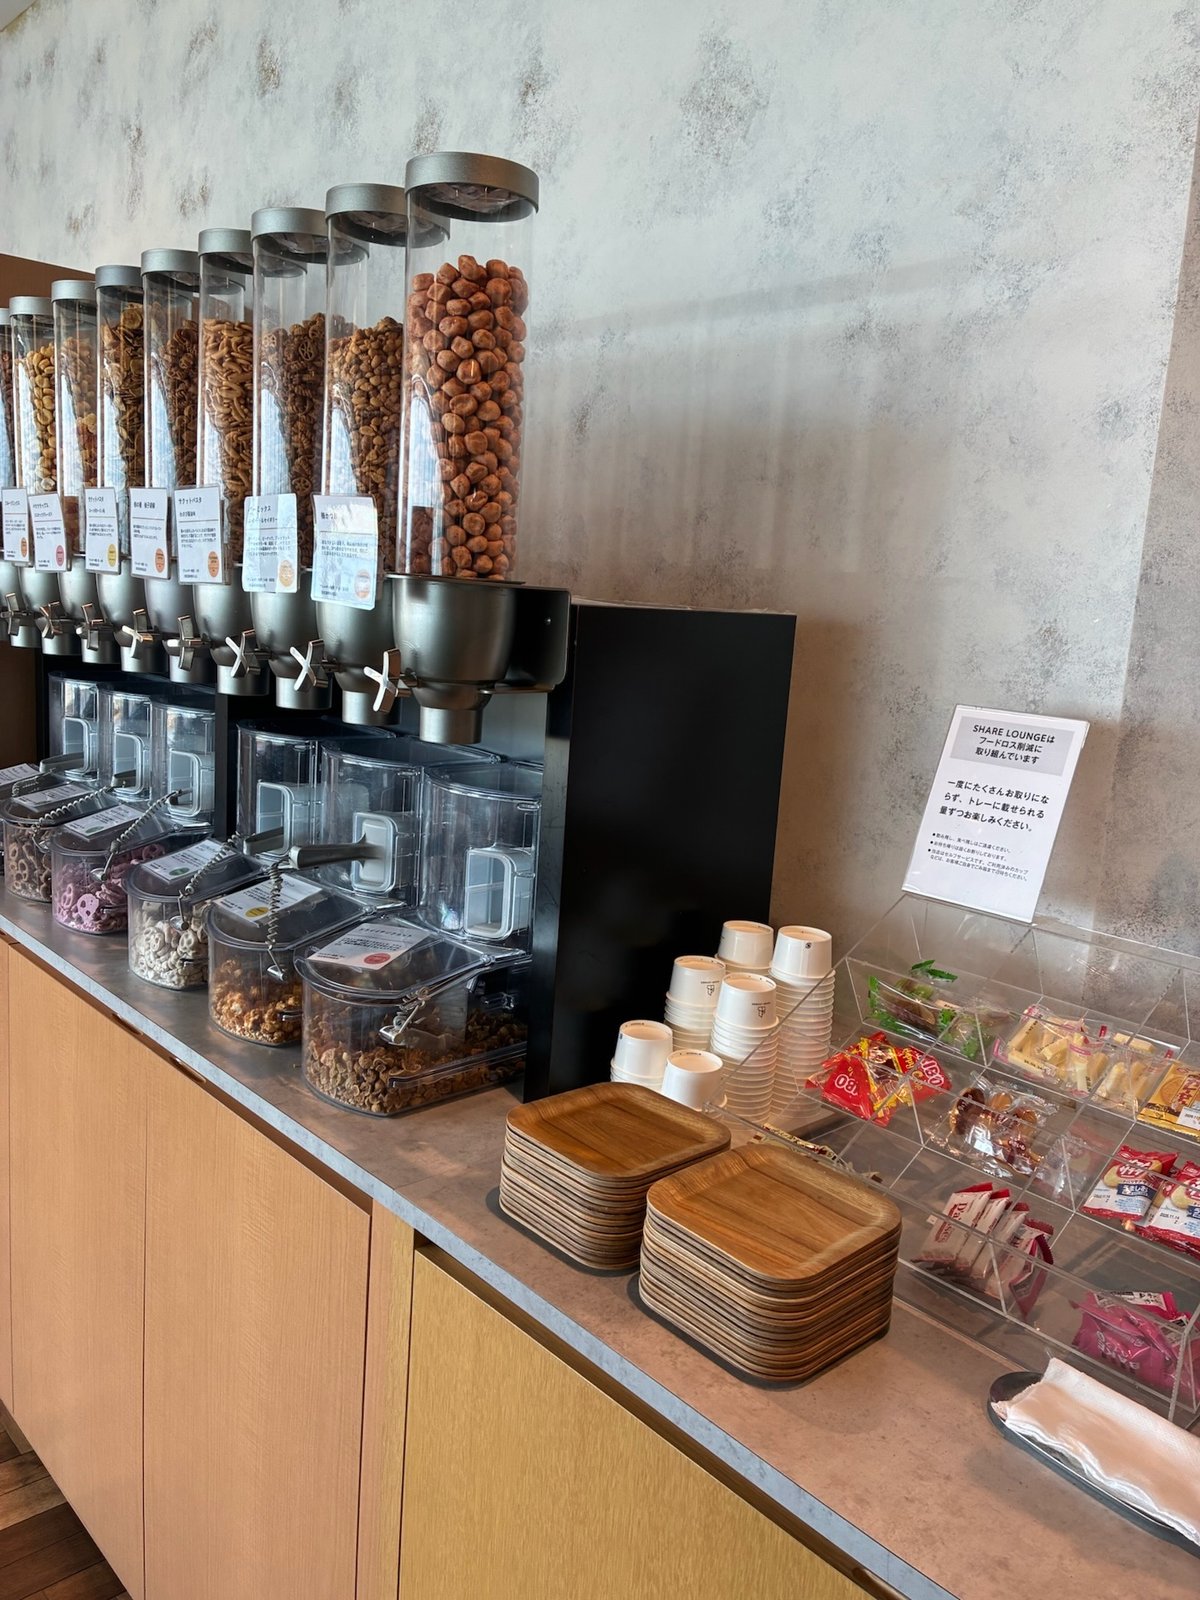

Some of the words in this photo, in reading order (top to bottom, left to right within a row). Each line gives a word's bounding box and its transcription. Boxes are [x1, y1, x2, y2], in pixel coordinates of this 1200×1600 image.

[973, 724, 1004, 736] SHARE
[1006, 729, 1055, 743] LOUNGEは
[979, 736, 1043, 753] フードロス削減に
[975, 747, 1040, 764] 取り組んでいます
[948, 780, 1050, 804] 一度にたくさんお取りにな
[944, 792, 1045, 819] らず、トレーに載せられる
[939, 805, 1032, 832] 量ずつお楽しみください。
